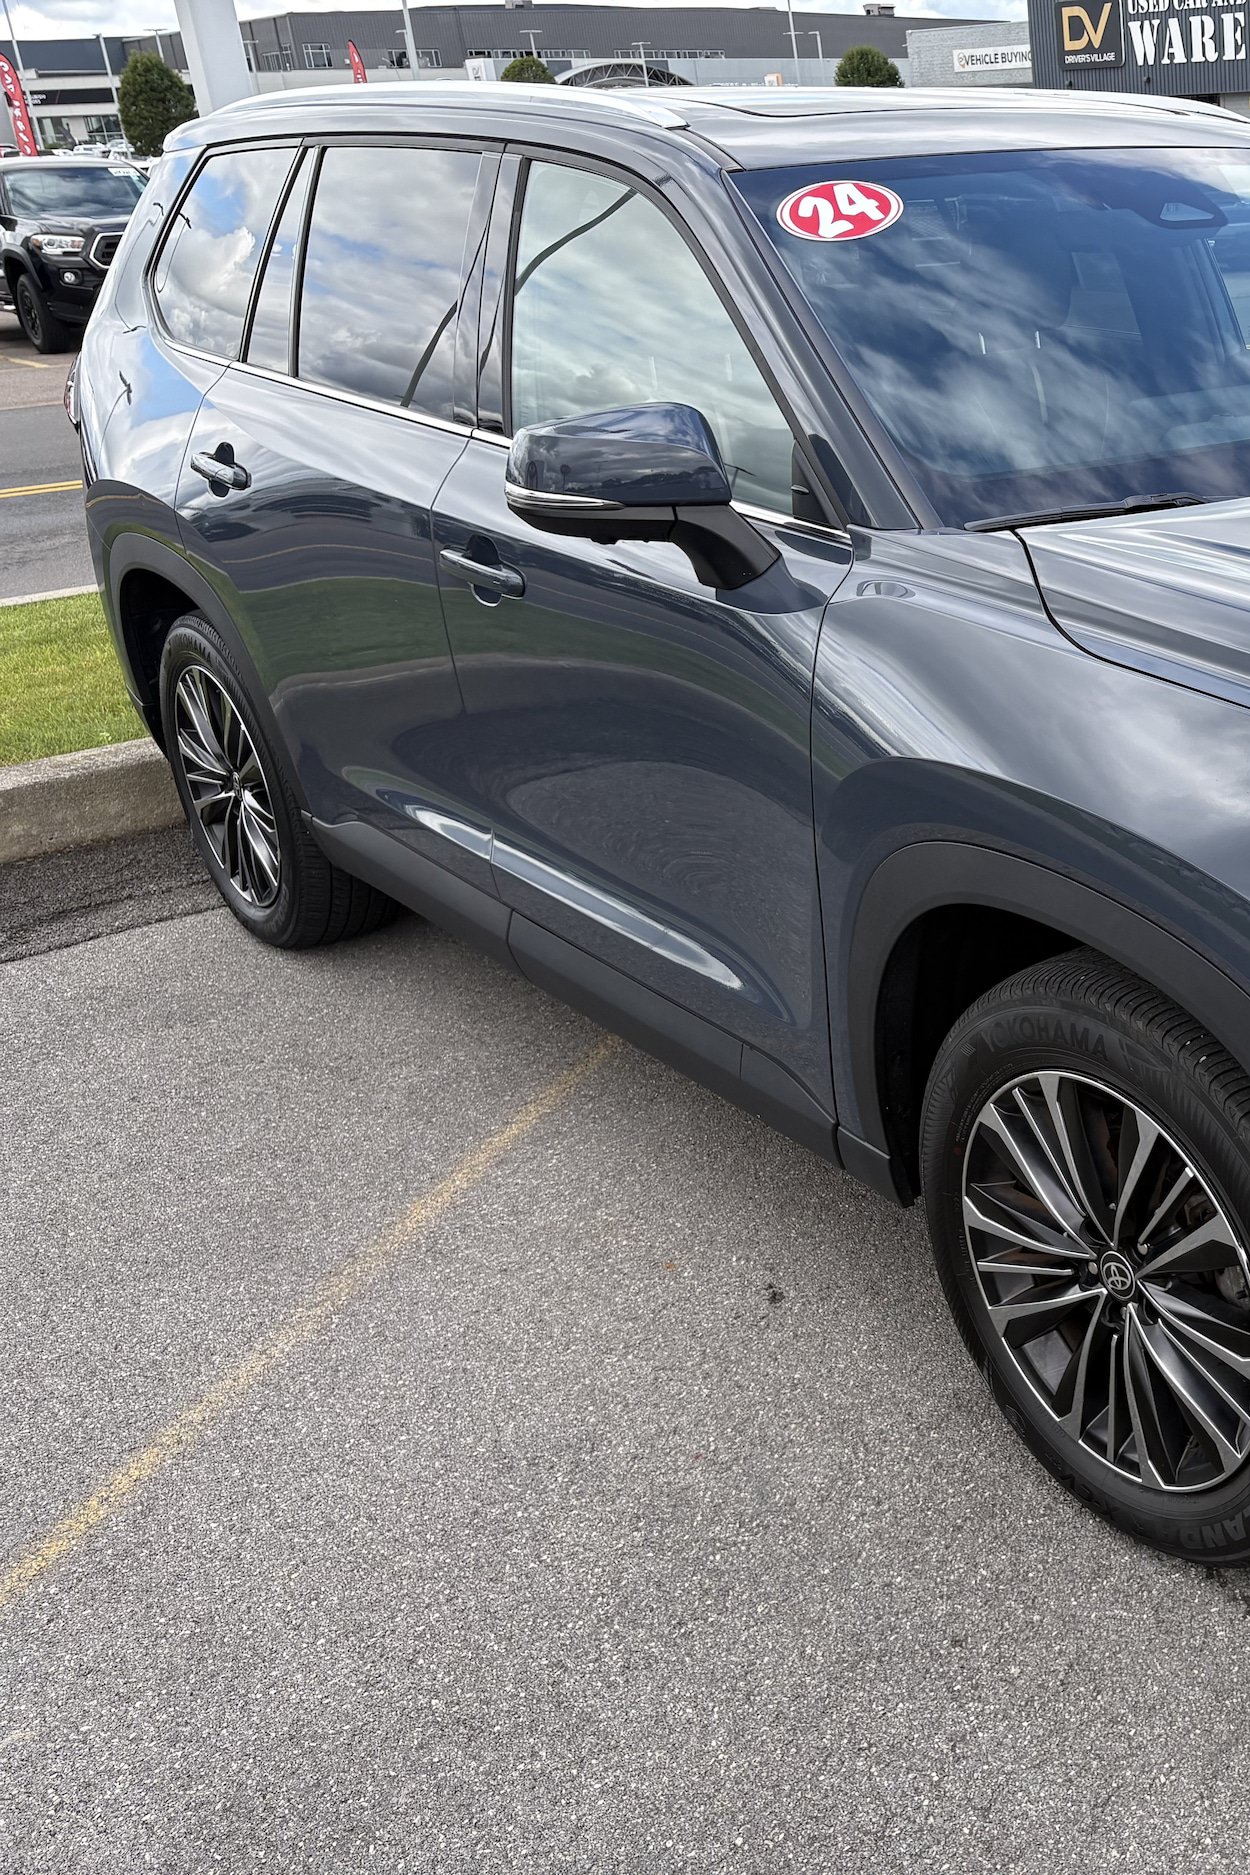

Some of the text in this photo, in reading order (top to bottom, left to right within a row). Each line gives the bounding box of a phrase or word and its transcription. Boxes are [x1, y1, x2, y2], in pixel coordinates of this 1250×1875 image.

[964, 53, 1000, 66] VEHICLE
[1064, 52, 1116, 64] DRIVER'S VILLAGE
[797, 183, 886, 238] 24
[980, 1015, 1109, 1062] YOKOHAMA
